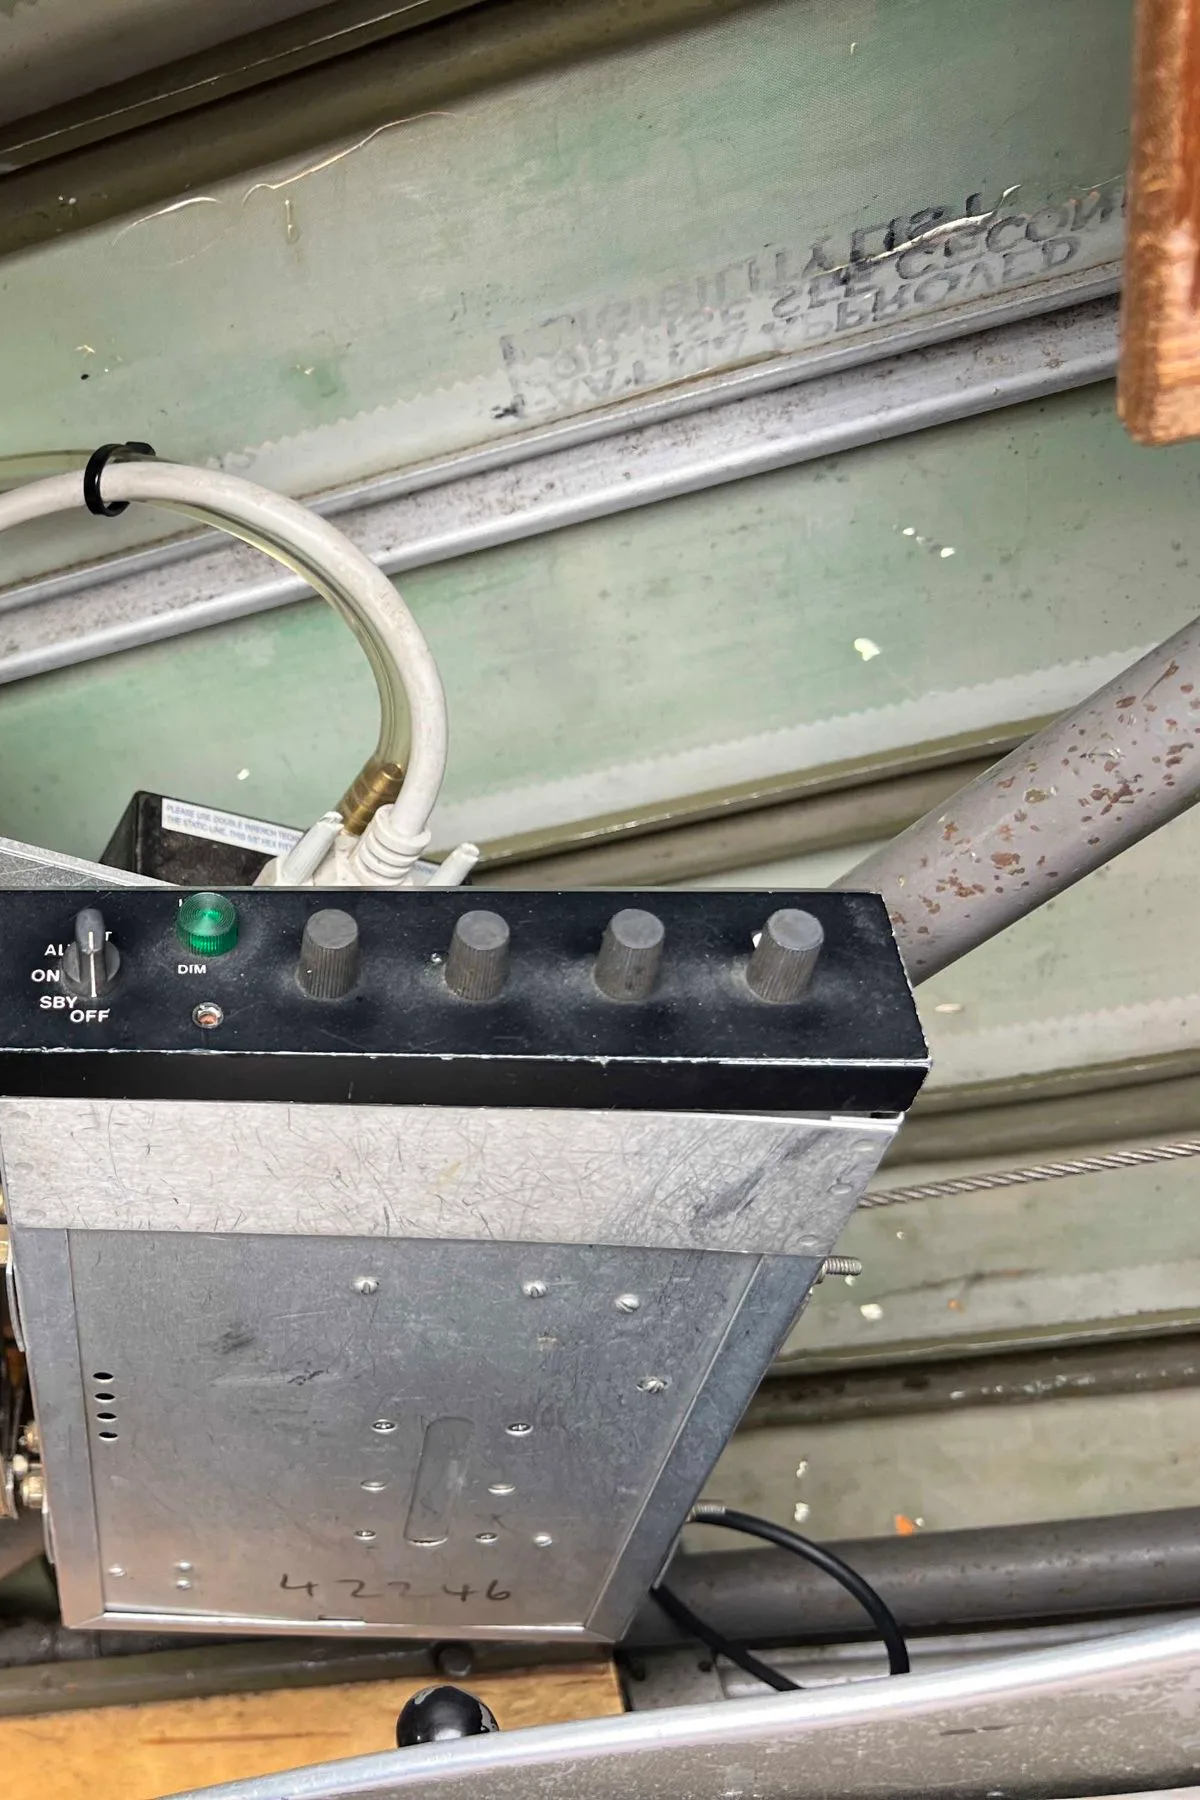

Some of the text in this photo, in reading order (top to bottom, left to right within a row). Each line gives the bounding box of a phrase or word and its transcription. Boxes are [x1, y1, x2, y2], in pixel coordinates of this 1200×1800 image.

[31, 969, 61, 983] ON
[177, 964, 207, 975] DIM
[39, 995, 79, 1010] SBY
[69, 1008, 111, 1023] OFF
